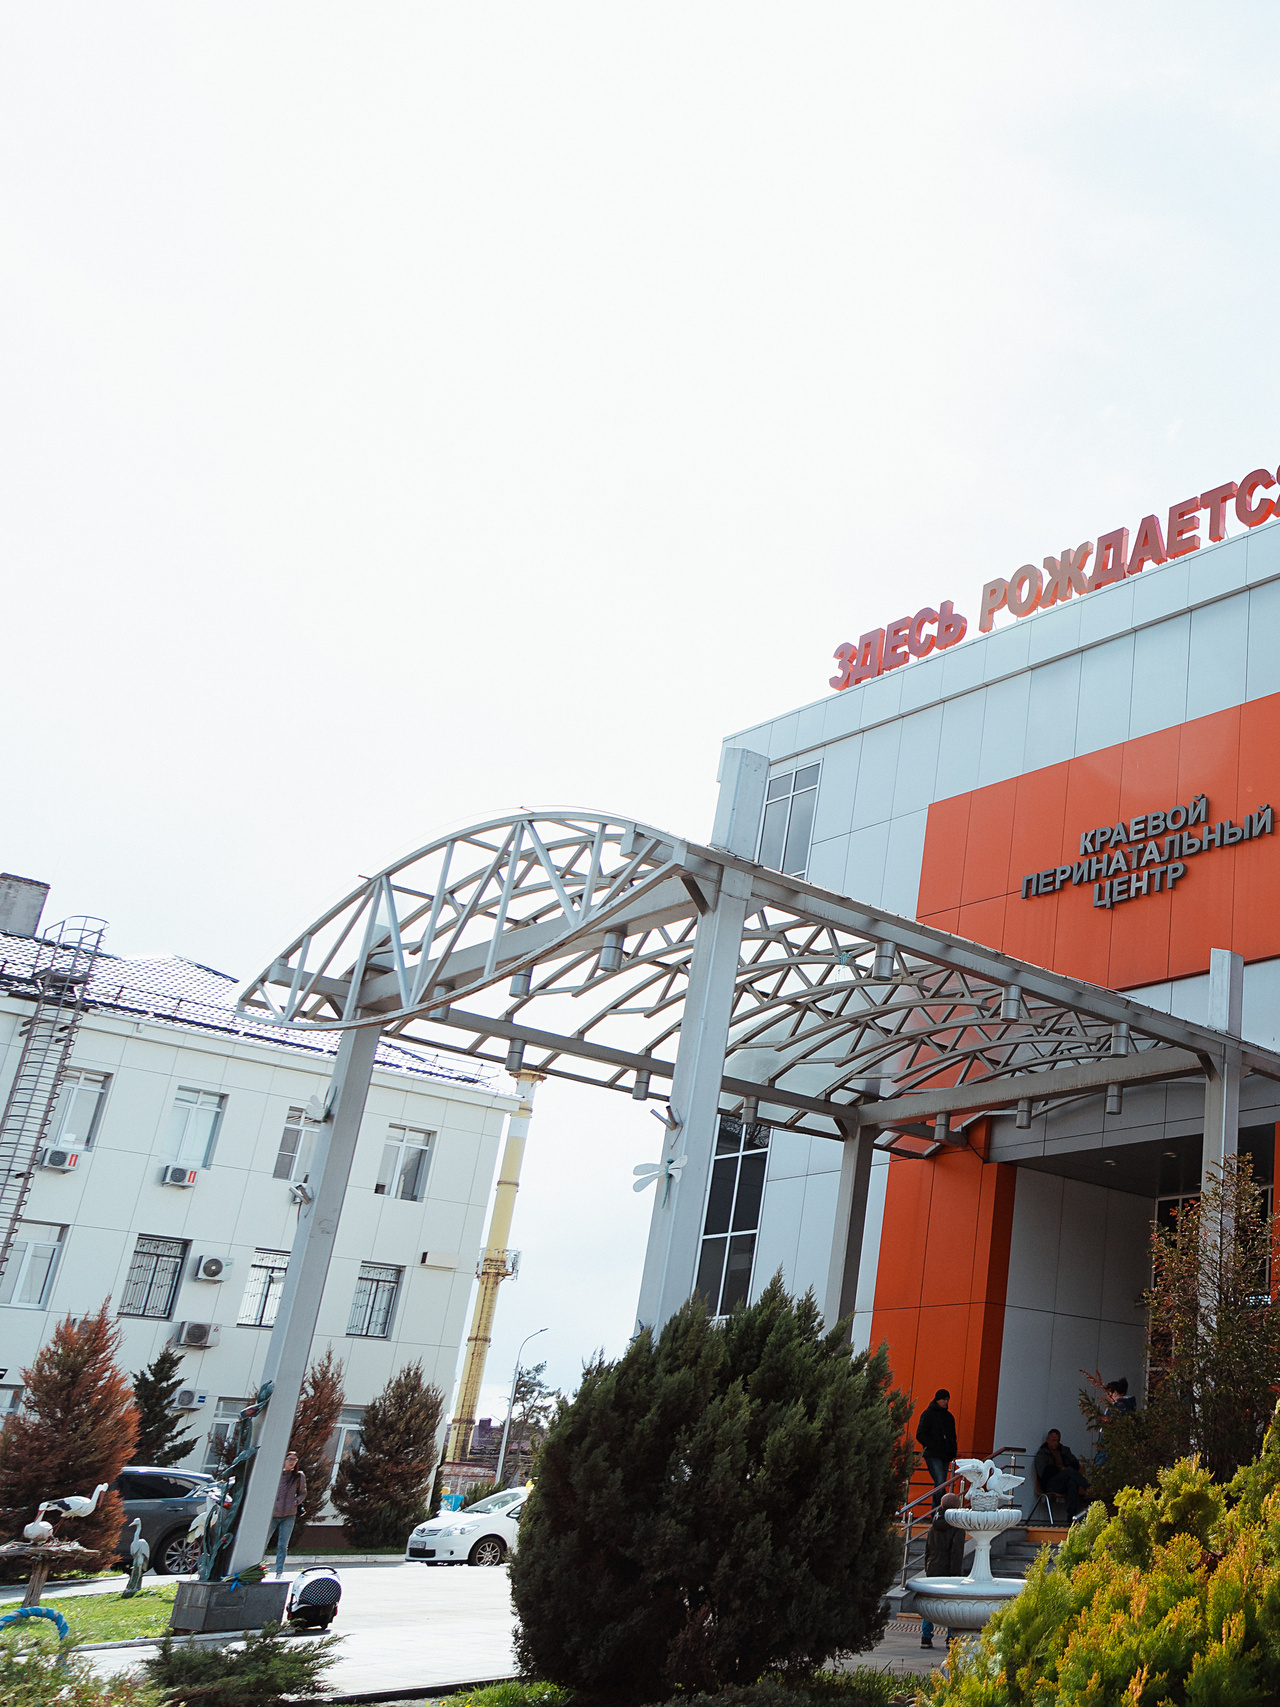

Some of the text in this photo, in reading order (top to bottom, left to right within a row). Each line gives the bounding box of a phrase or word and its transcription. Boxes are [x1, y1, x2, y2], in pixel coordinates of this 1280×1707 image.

[829, 600, 968, 691] ЗДЕСЬ
[1021, 803, 1274, 899] ПЕРИНАТАЛЬНЫЙ
[1080, 793, 1208, 856] КРАЕВОЙ
[1093, 862, 1187, 909] ЦЕНТР
